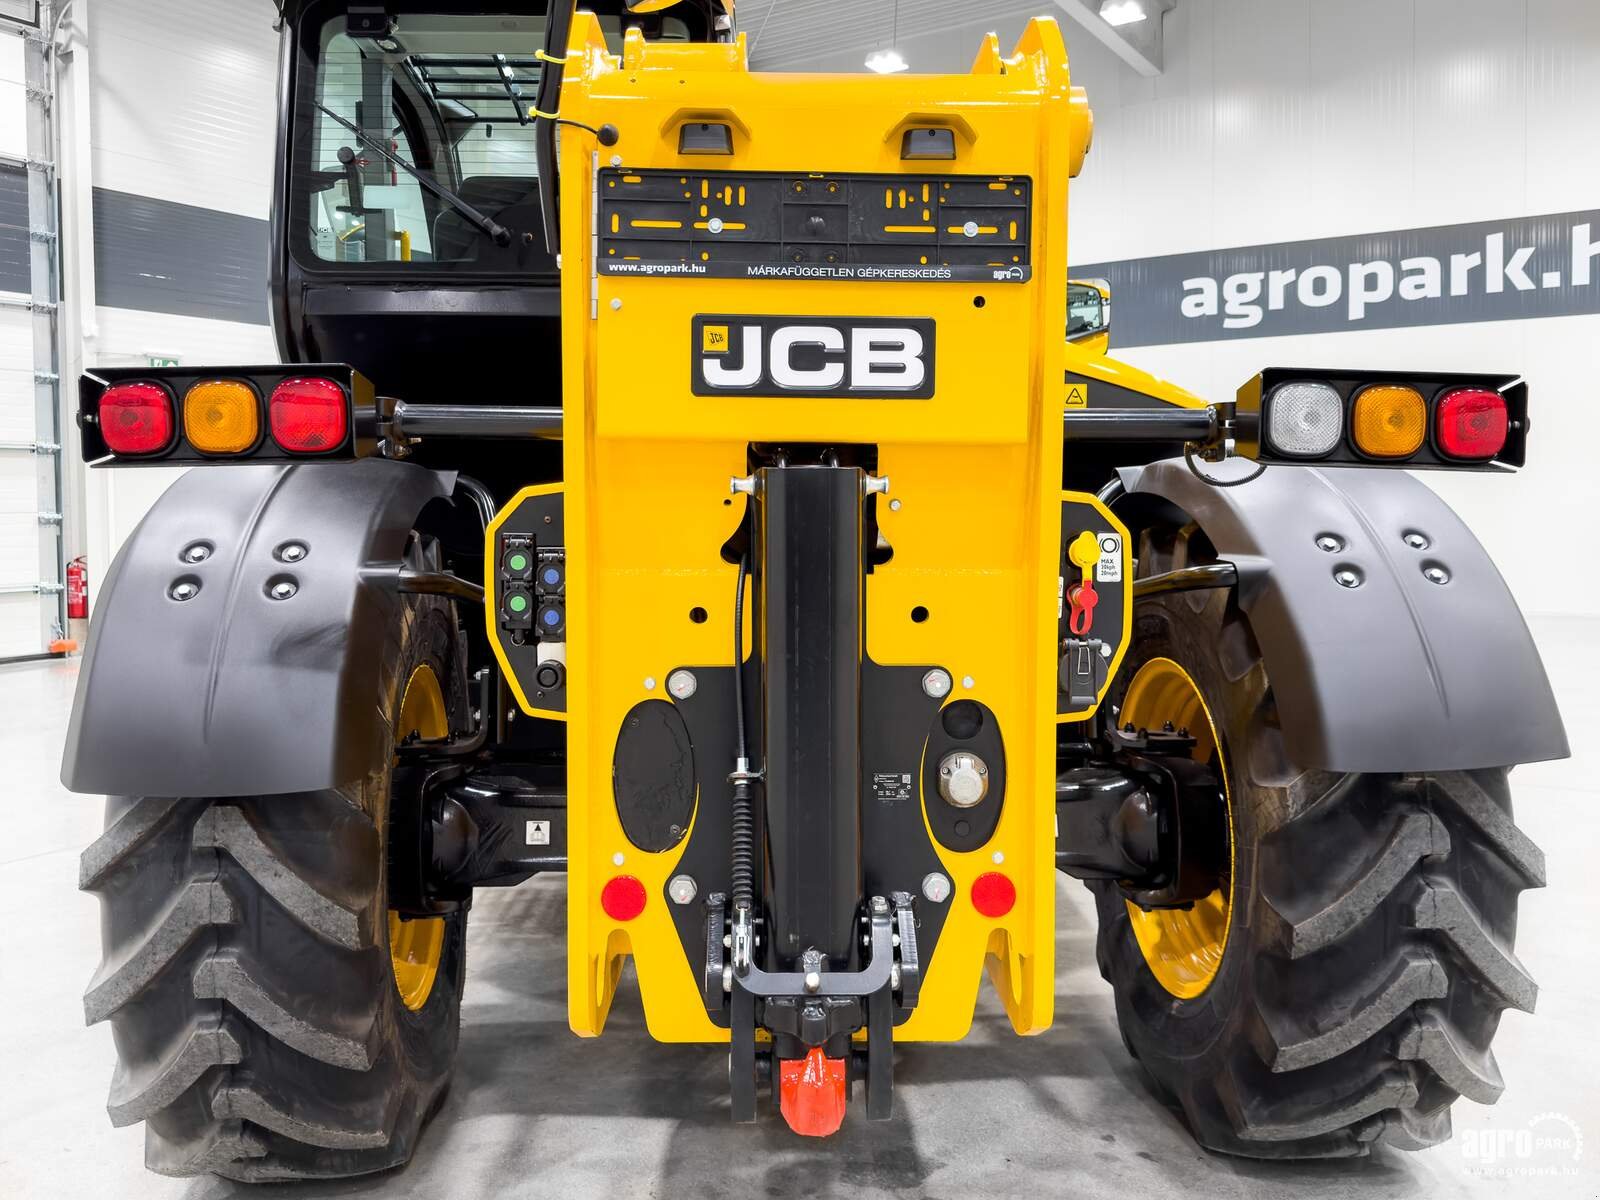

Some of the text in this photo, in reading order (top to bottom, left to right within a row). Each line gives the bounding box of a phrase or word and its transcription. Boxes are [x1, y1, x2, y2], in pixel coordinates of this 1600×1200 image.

[608, 263, 706, 274] www.agropark.hu
[747, 264, 951, 279] MÁRKAFÜGGETLEN GÉPKERESKEDÉS
[993, 270, 1011, 280] agro
[709, 331, 724, 344] JCB
[702, 325, 925, 391] JCB
